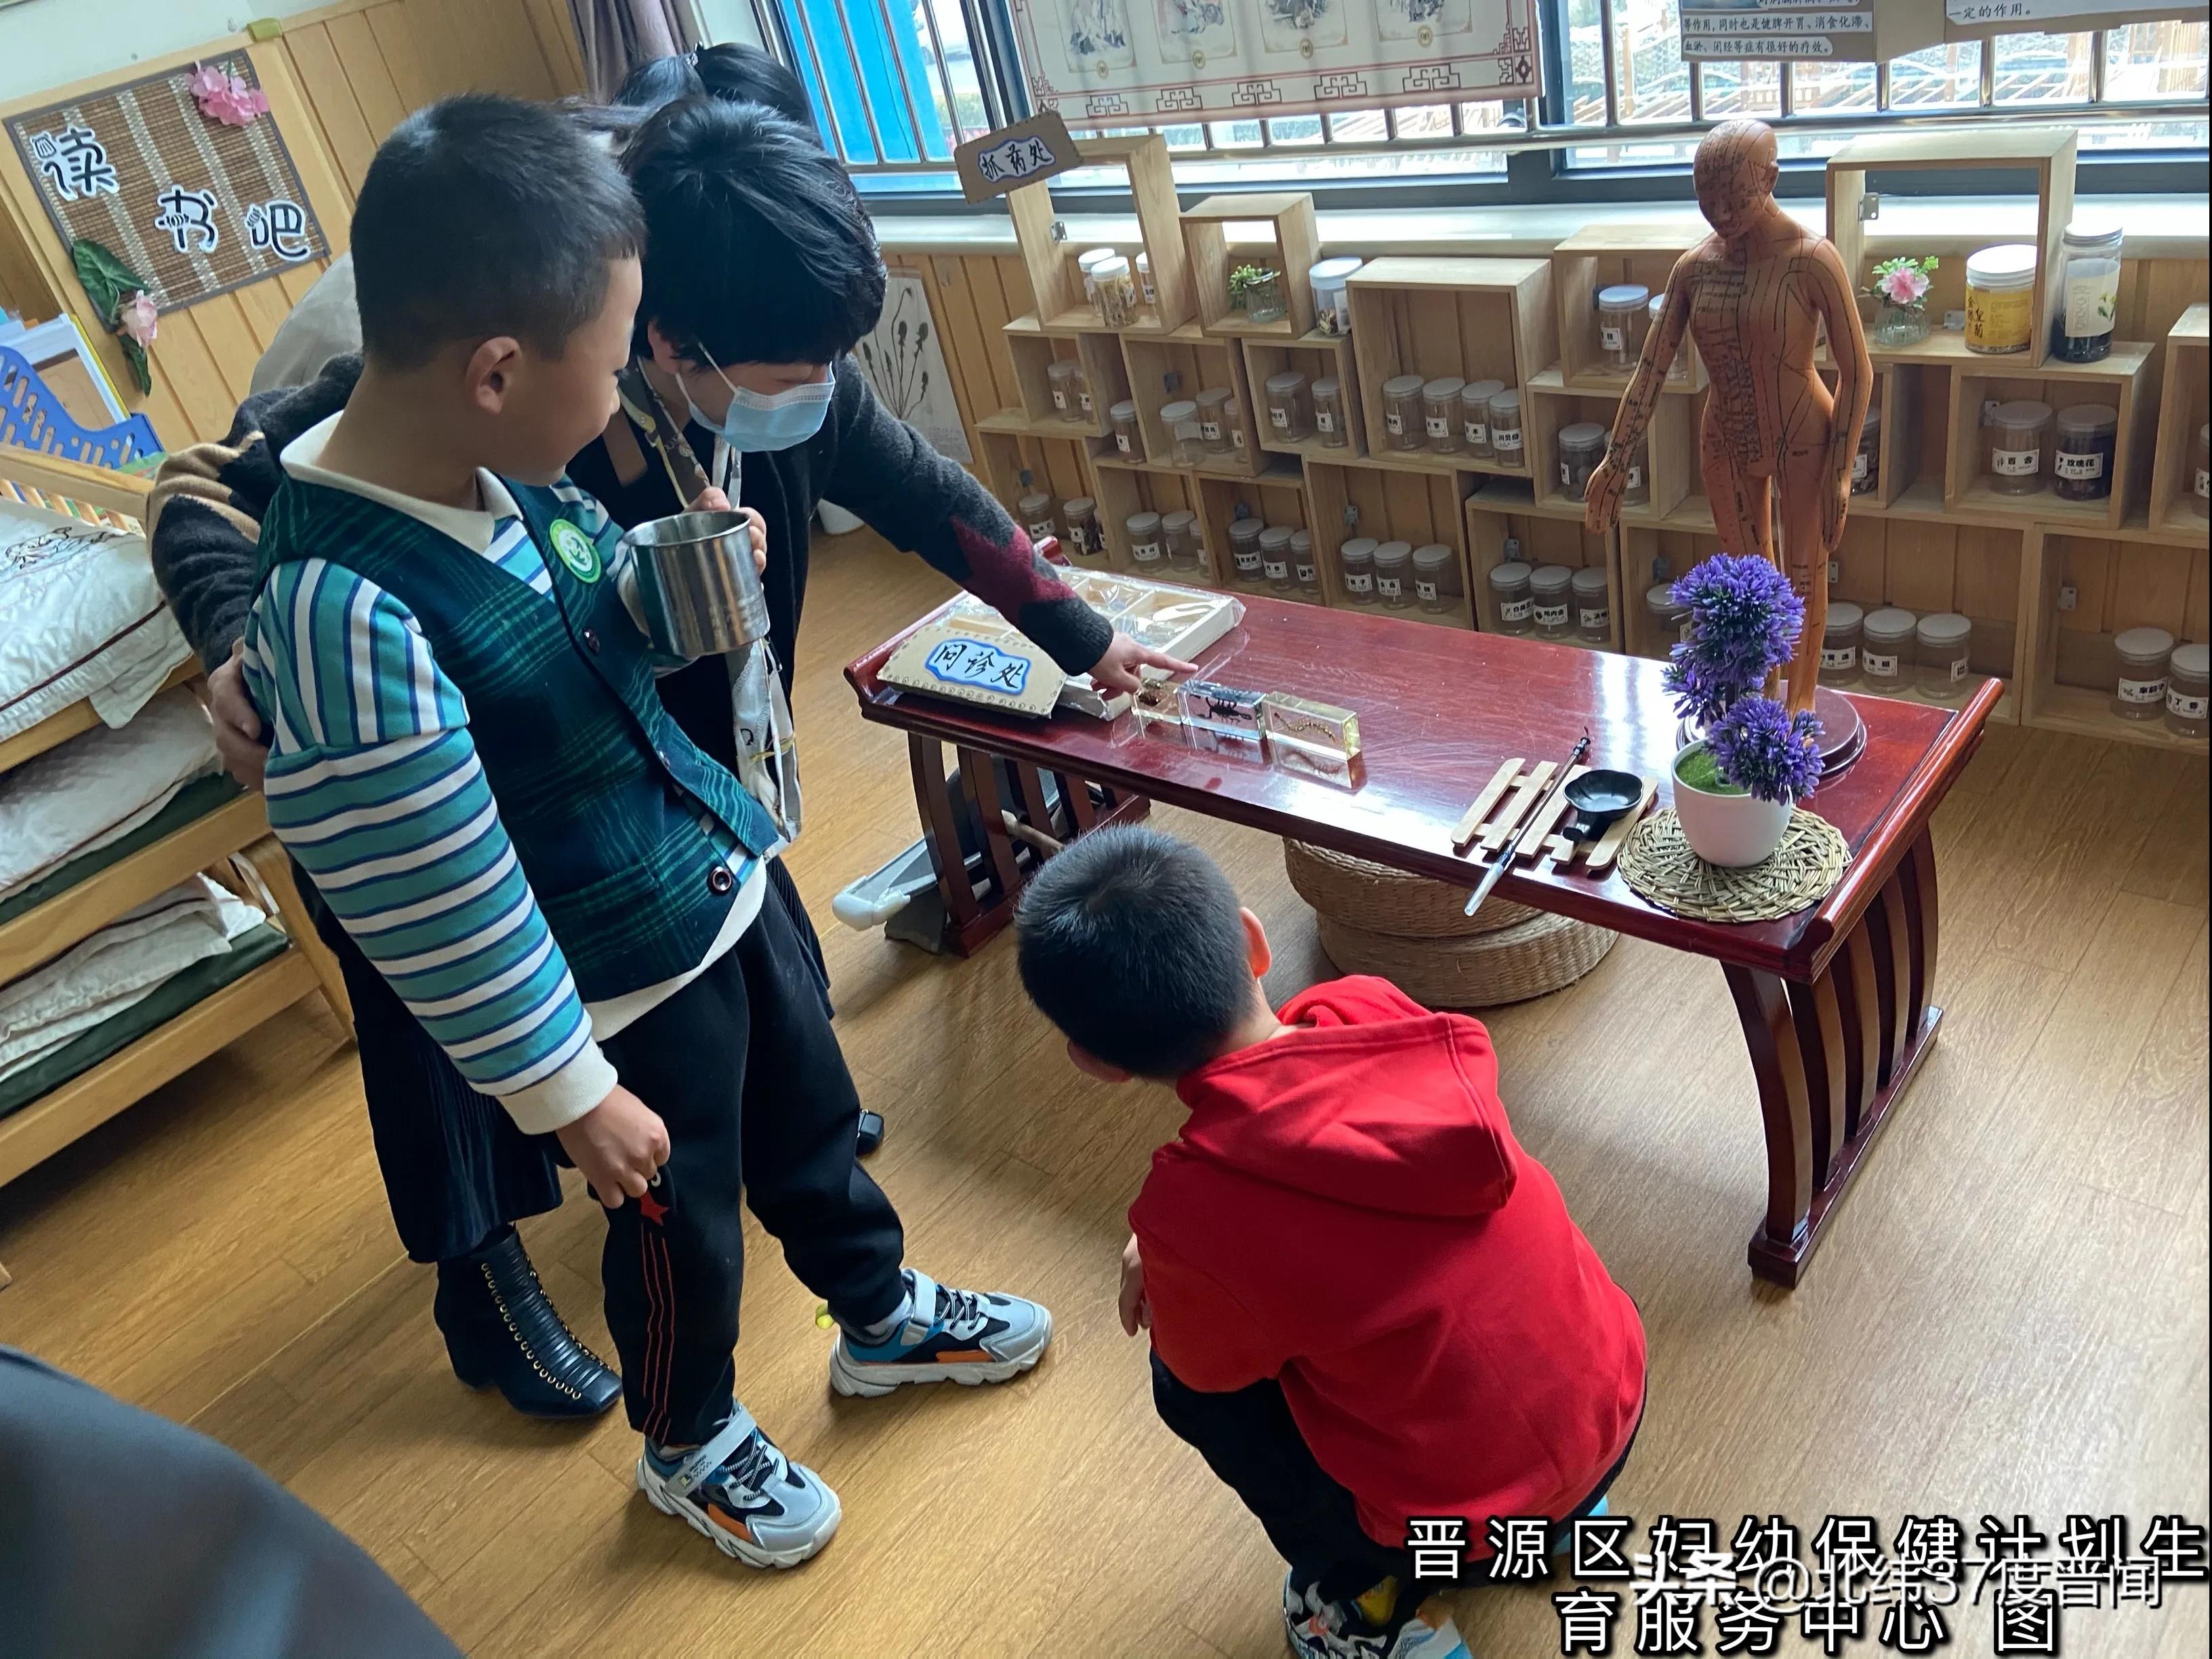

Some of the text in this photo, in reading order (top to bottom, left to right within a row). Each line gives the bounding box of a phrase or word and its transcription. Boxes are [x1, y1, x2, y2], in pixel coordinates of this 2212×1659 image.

[1948, 3, 2031, 20] 一定的作用。
[981, 140, 1052, 180] 抓药处
[31, 125, 310, 261] 读书吧
[2067, 458, 2095, 468] 玫瑰花
[933, 643, 1027, 690] 问诊处
